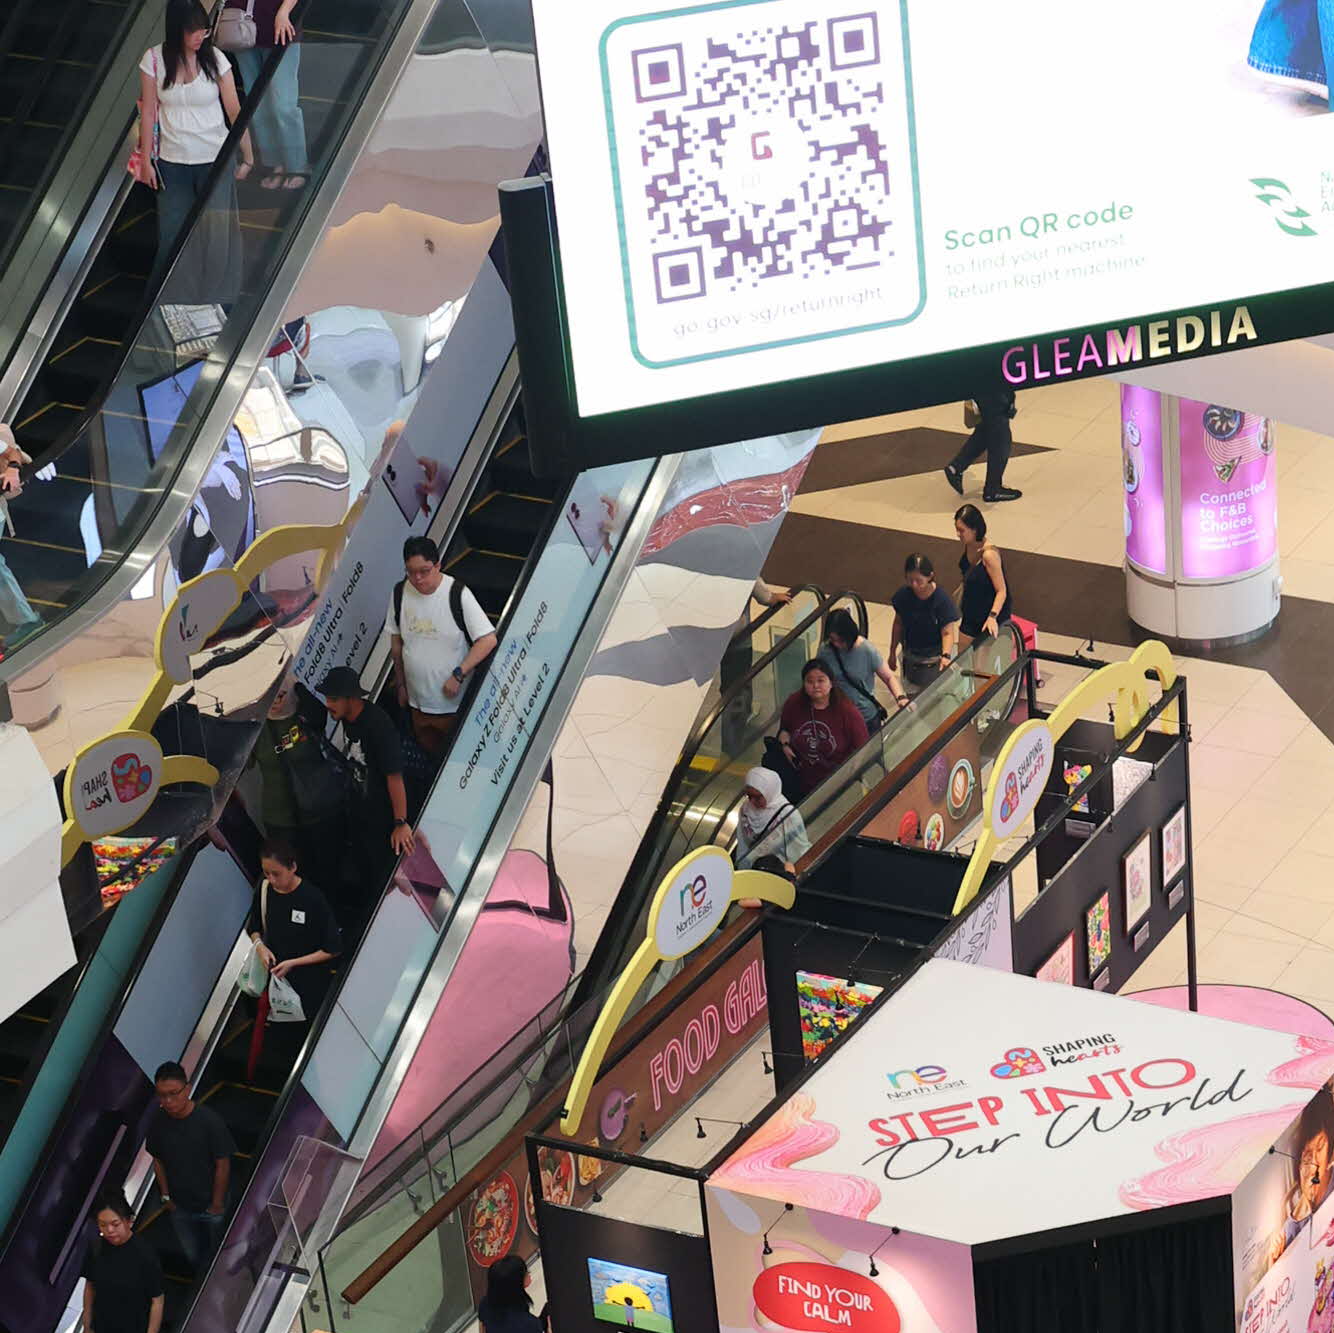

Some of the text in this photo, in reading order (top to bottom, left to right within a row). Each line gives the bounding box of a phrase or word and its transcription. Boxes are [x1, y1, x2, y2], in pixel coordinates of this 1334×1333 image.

[944, 201, 1135, 251] Scan QR code
[947, 275, 1010, 300] Return
[1012, 264, 1061, 296] Right
[1002, 305, 1259, 385] GLEAMEDIA
[1199, 480, 1267, 505] Connected
[1199, 501, 1248, 520] to F&B
[1200, 513, 1254, 533] Choices
[303, 561, 365, 686] Fold8 Ultra Fold8
[345, 621, 370, 667] evel 2
[458, 600, 549, 792] Galaxy Z Fold8 Ultra Fold8
[473, 697, 492, 728] The
[489, 660, 551, 787] Visit us at Level 2
[1016, 737, 1044, 780] SHAPING
[1019, 753, 1045, 796] hearts
[679, 874, 708, 917] ne
[674, 910, 698, 936] North
[696, 900, 714, 922] East
[649, 958, 769, 1112] FOOD GAL
[1042, 1032, 1116, 1058] SHAPING
[1050, 1041, 1125, 1068] hearts
[885, 1064, 949, 1091] ne
[886, 1077, 969, 1102] North East
[867, 1057, 1197, 1148] STEP INTO
[861, 1068, 1254, 1181] Our World
[777, 1275, 875, 1312] FIND YOUR
[802, 1301, 853, 1327] CALM
[1264, 1276, 1292, 1319] INTO
